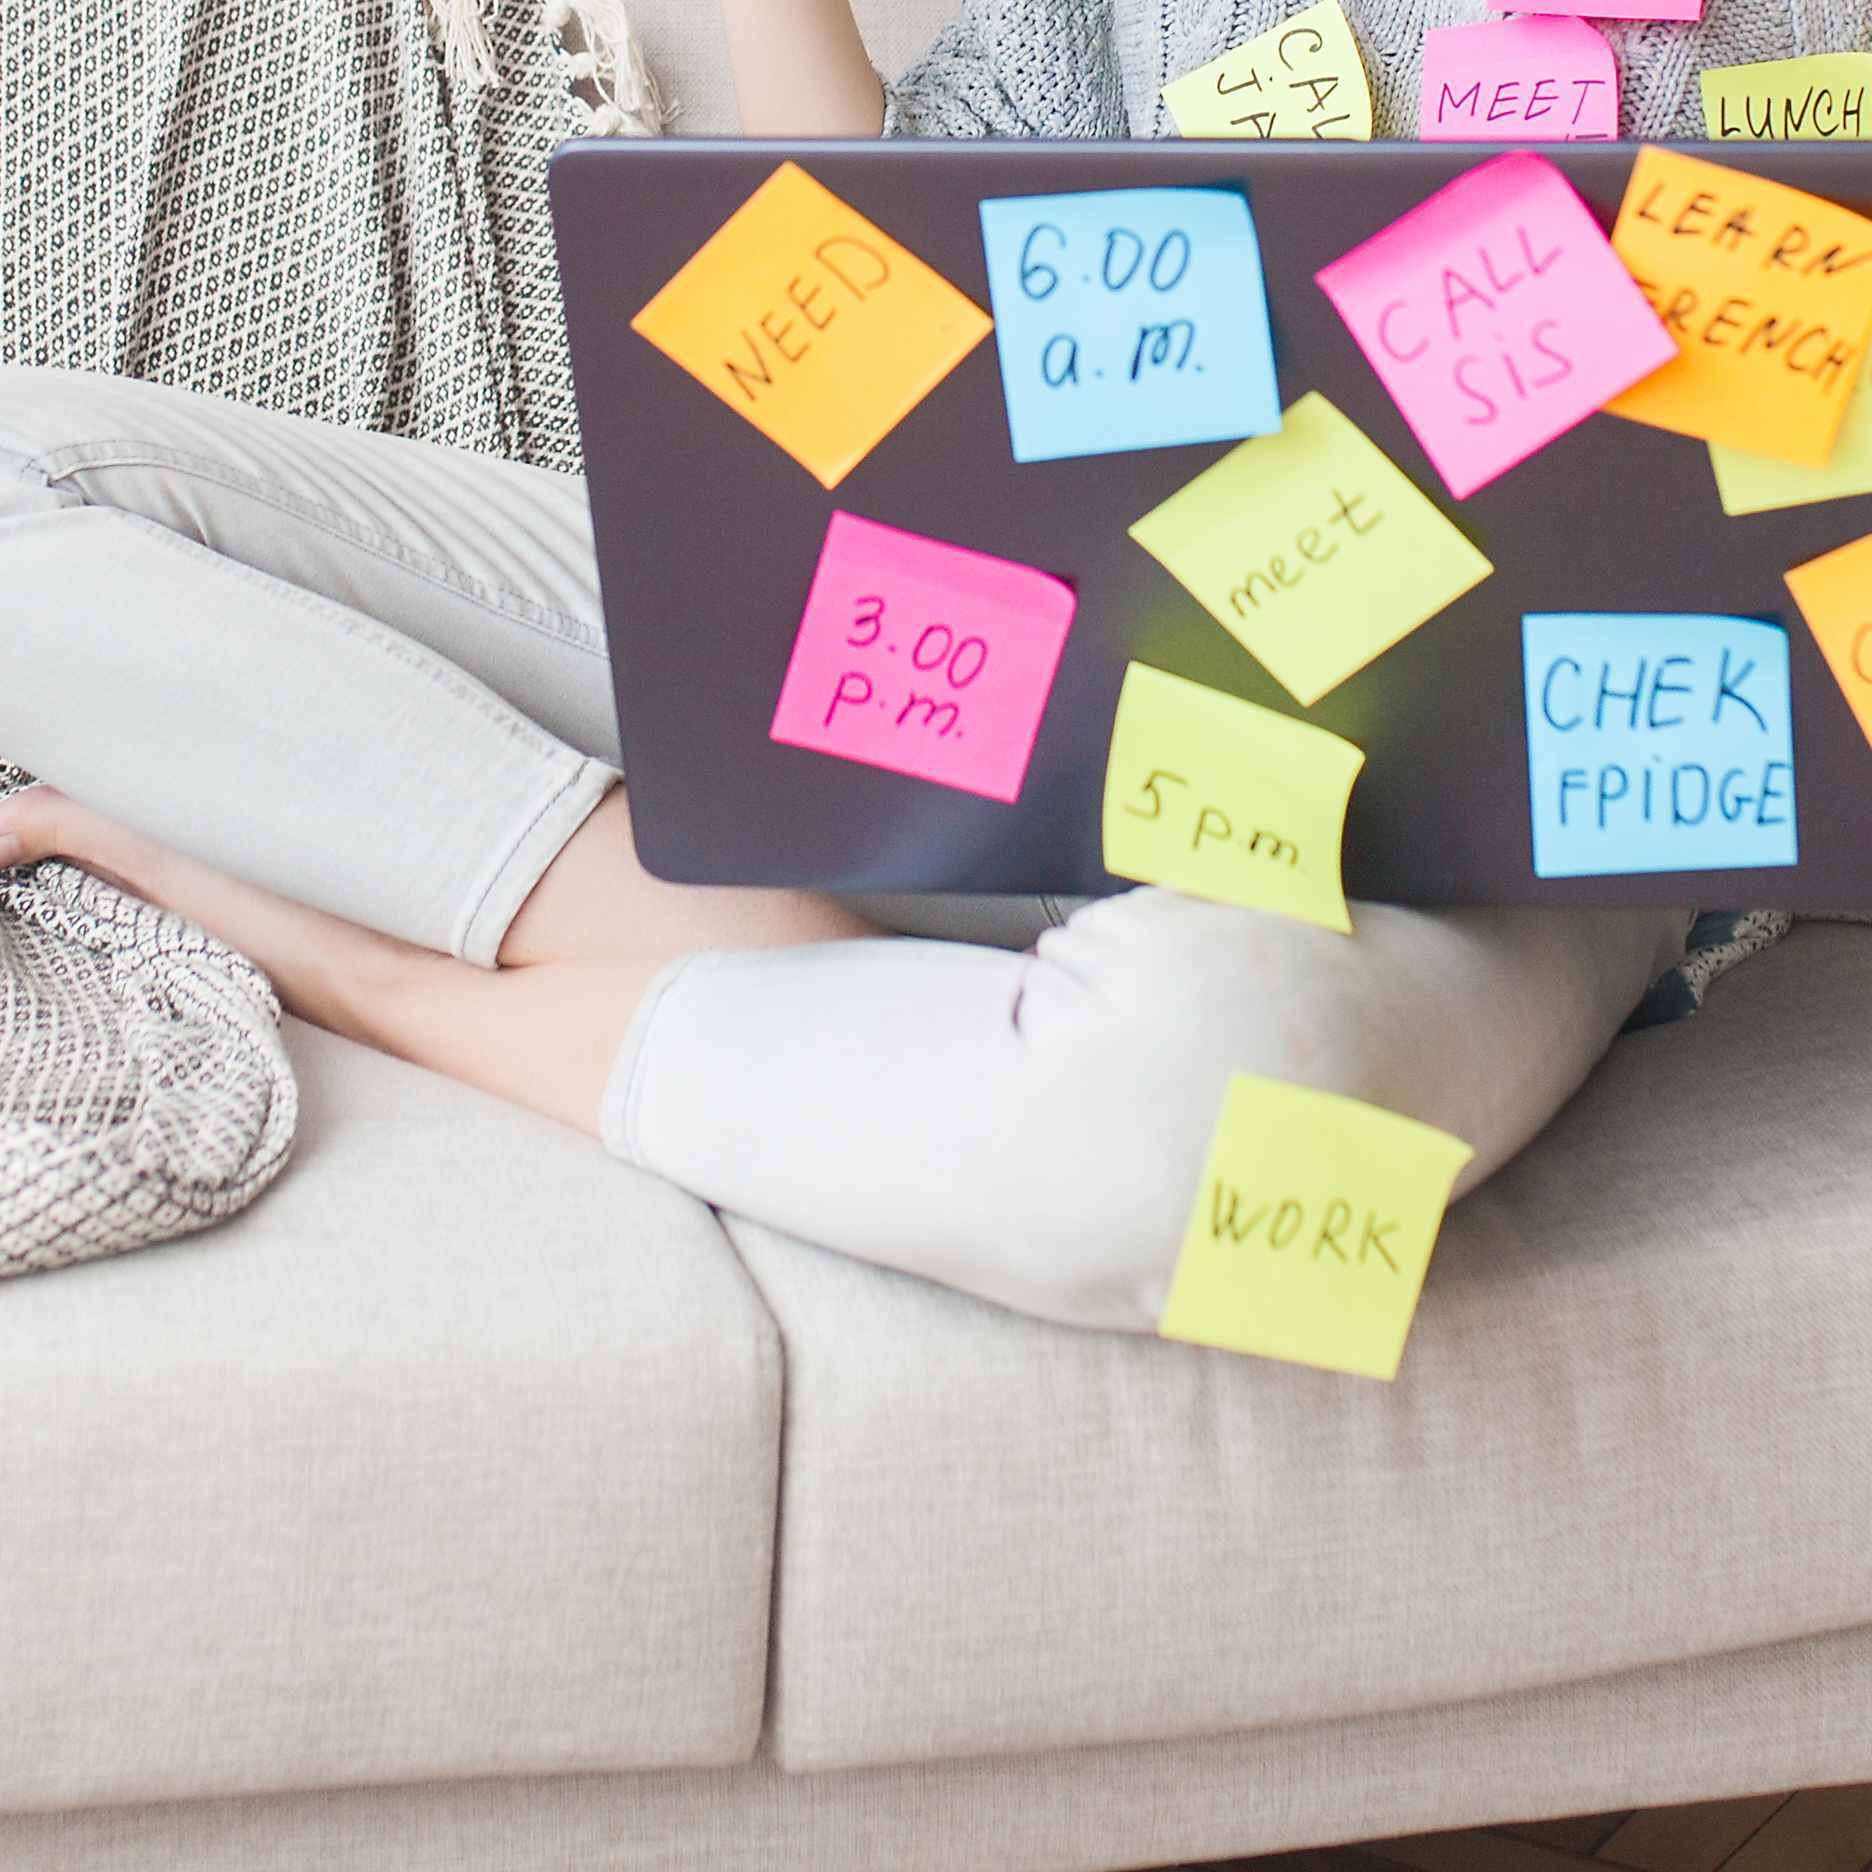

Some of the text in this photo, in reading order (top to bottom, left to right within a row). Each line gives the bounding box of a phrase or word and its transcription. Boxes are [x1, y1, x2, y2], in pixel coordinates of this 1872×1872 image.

[1438, 79, 1606, 125] MEET
[1720, 86, 1865, 141] LUNCH
[1019, 222, 1191, 301] 6.00
[1376, 224, 1564, 366] CALL
[722, 234, 892, 404] NEED
[1228, 486, 1385, 618] meet
[845, 594, 990, 689] 3.00
[1542, 645, 1770, 734] CHEK
[1209, 1178, 1402, 1276] WORK
